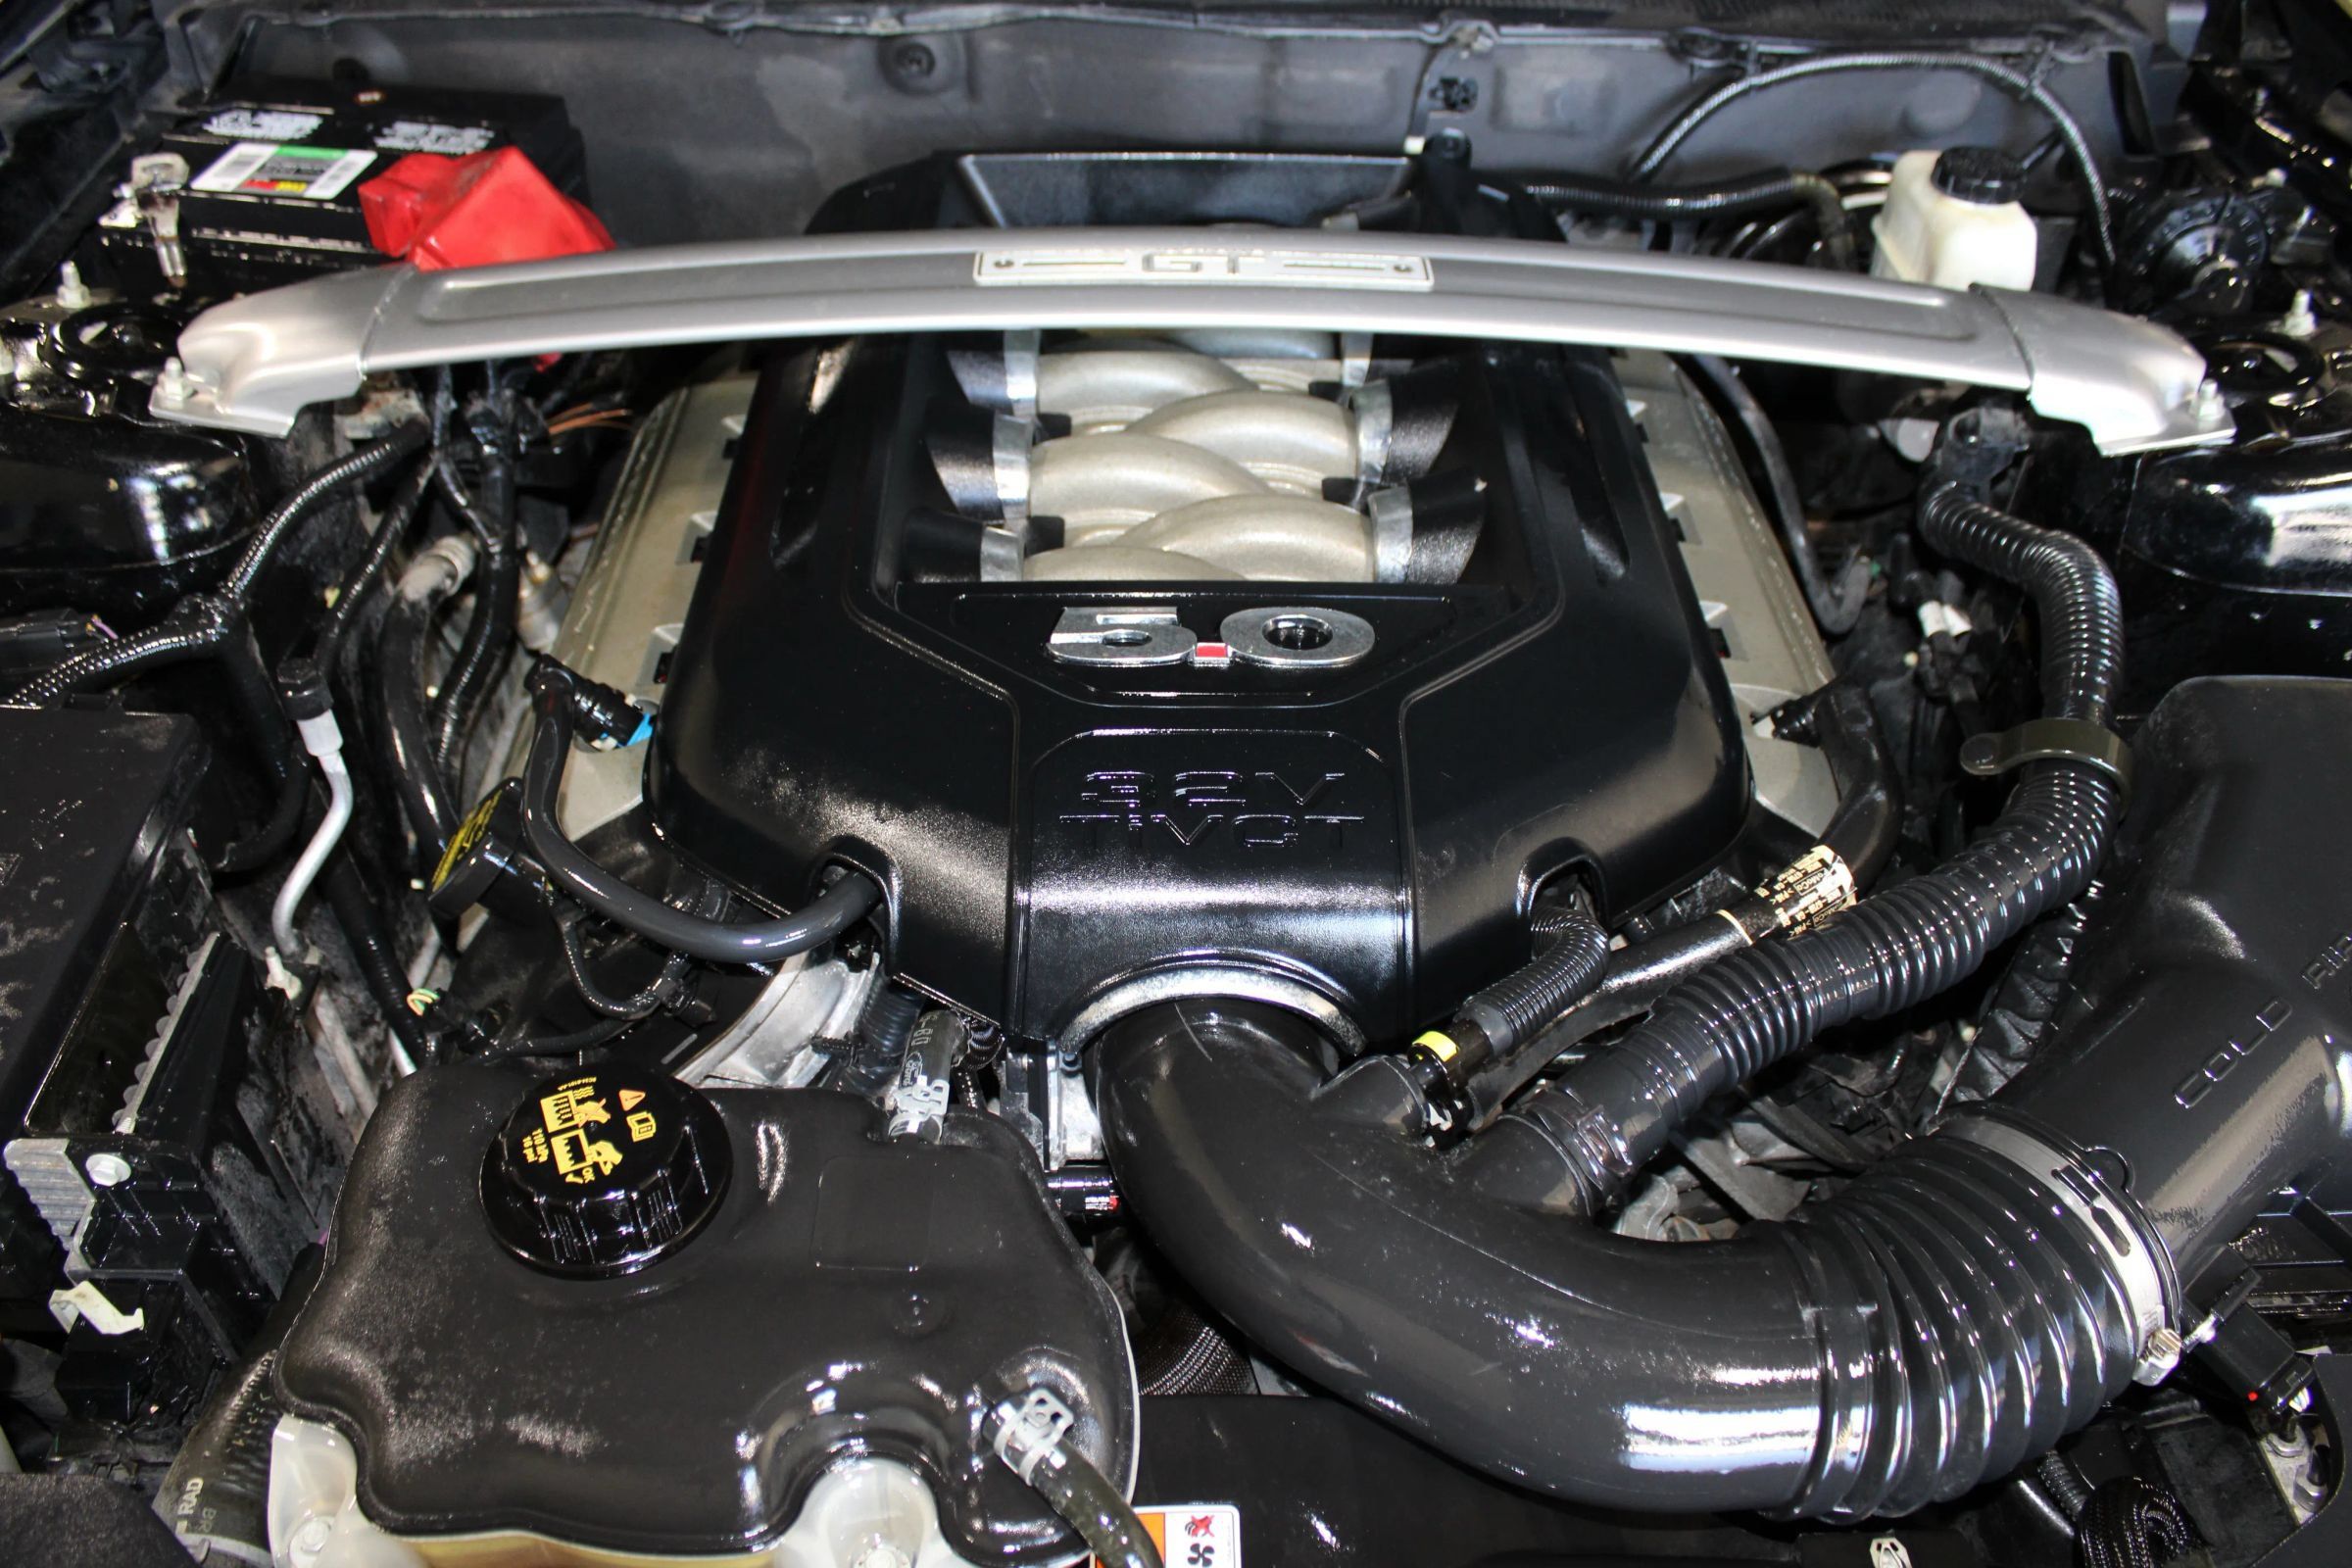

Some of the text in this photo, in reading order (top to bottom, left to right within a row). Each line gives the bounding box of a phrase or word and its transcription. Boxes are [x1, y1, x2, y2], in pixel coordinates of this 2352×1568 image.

[1142, 253, 1266, 274] GT
[1080, 770, 1346, 808] 32V
[2174, 996, 2293, 1109] COLD
[581, 1167, 595, 1184] OK
[177, 1477, 204, 1515] RAD
